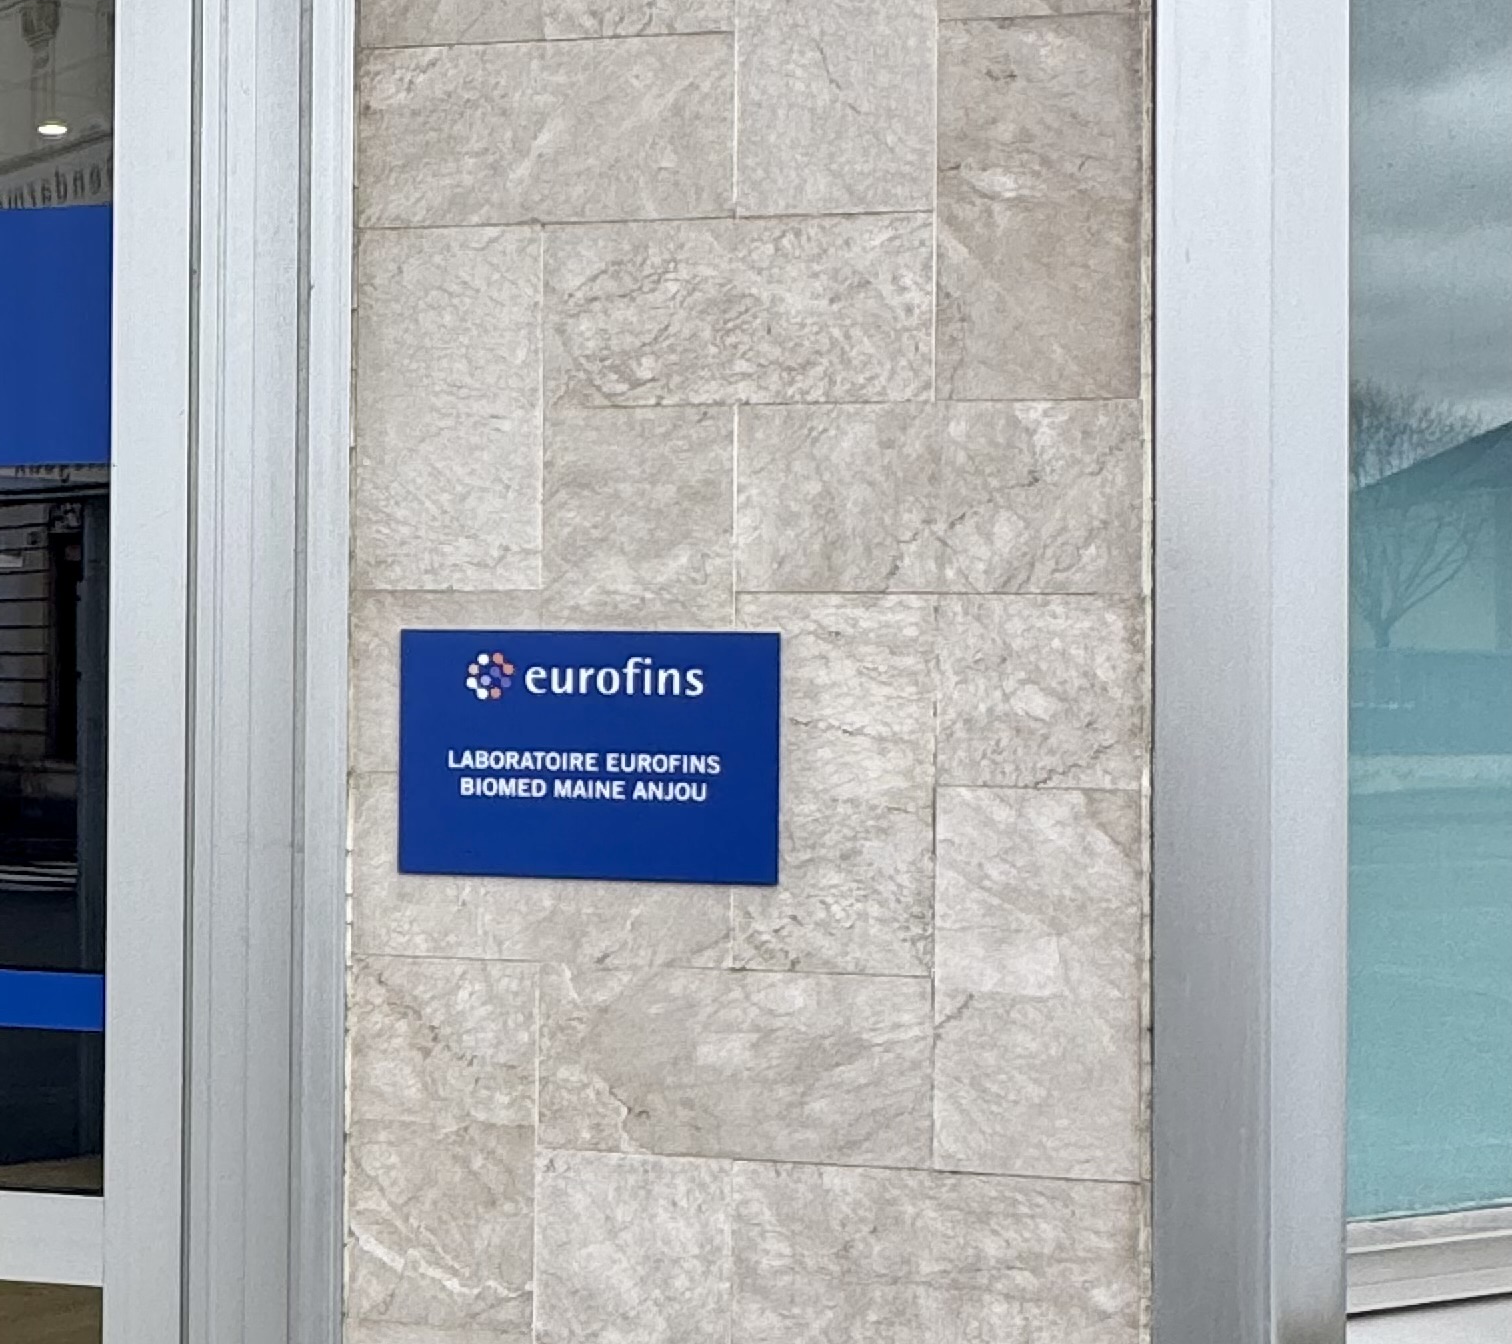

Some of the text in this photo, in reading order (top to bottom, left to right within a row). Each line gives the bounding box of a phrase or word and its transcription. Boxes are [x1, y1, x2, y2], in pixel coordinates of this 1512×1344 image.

[524, 656, 705, 697] eurofins
[448, 749, 722, 775] LABORATOIRE EUROFINS
[460, 776, 708, 803] BIOMED MAINE ANJOU
